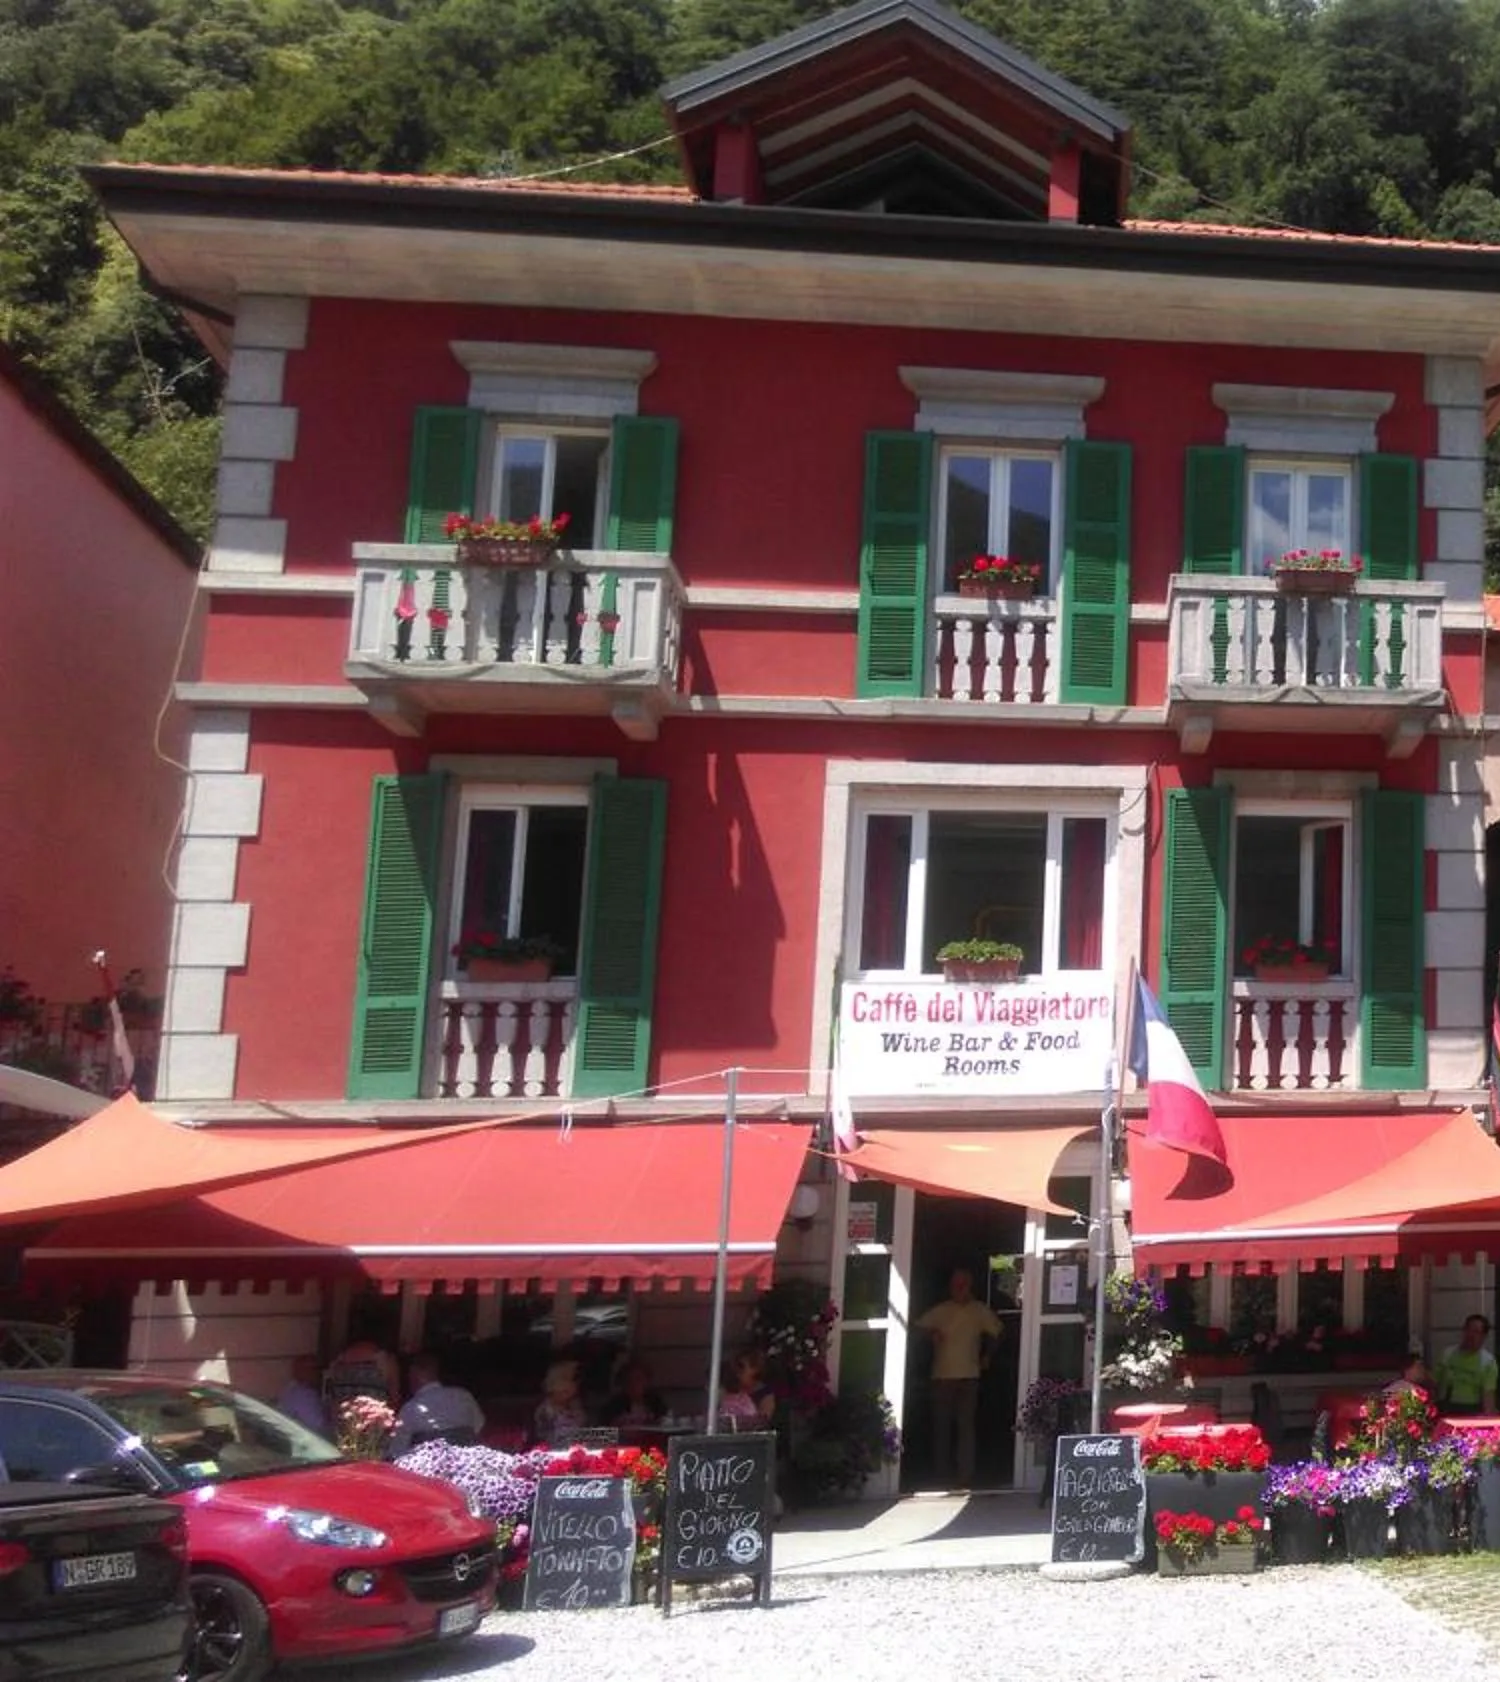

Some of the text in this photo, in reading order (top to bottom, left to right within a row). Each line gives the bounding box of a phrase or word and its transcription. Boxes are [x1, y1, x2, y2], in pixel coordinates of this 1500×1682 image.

[852, 990, 1110, 1026] Caffè del Viaggiatore
[881, 1030, 1081, 1053] Wine Bar & Food
[942, 1055, 1021, 1077] Rooms
[554, 1479, 612, 1499] Coca-Cola
